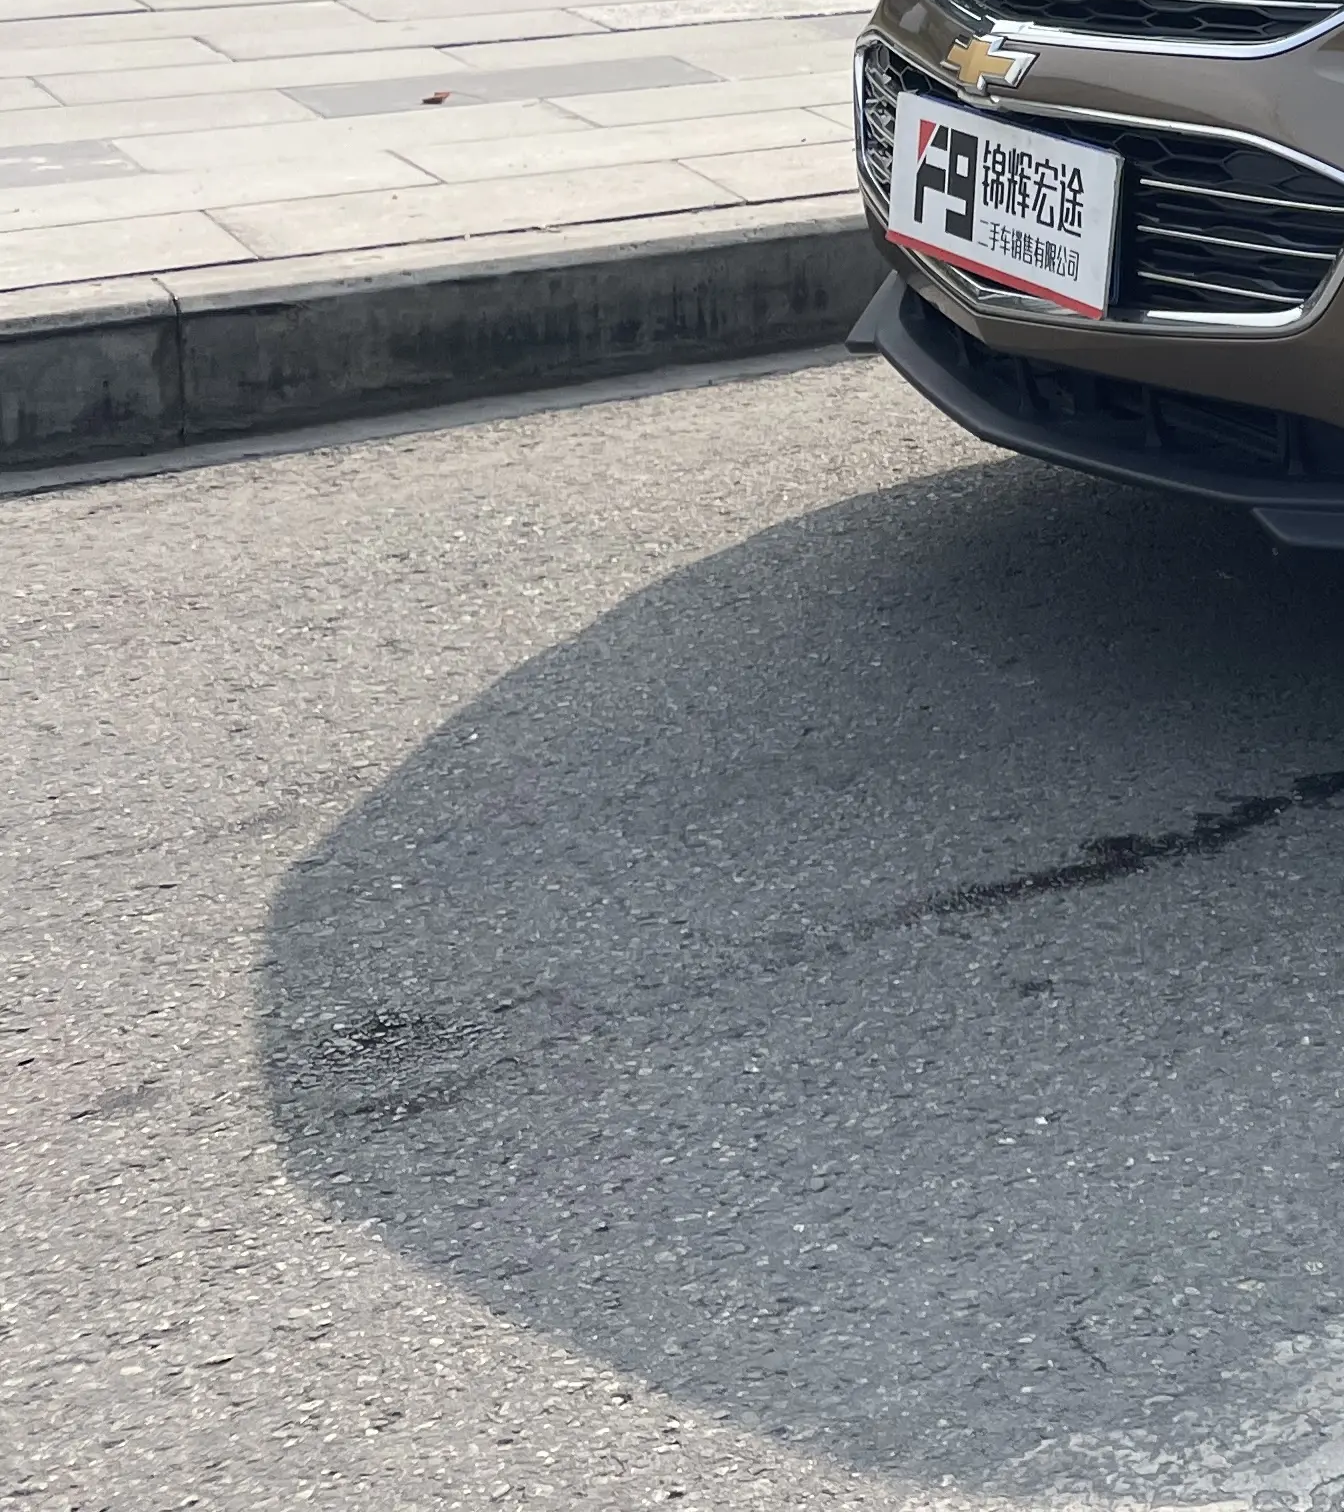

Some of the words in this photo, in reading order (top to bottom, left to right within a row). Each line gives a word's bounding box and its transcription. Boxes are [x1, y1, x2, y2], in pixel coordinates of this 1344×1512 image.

[981, 139, 1085, 238] 锦辉宏途
[977, 219, 1080, 282] 二手车销售有限公司
